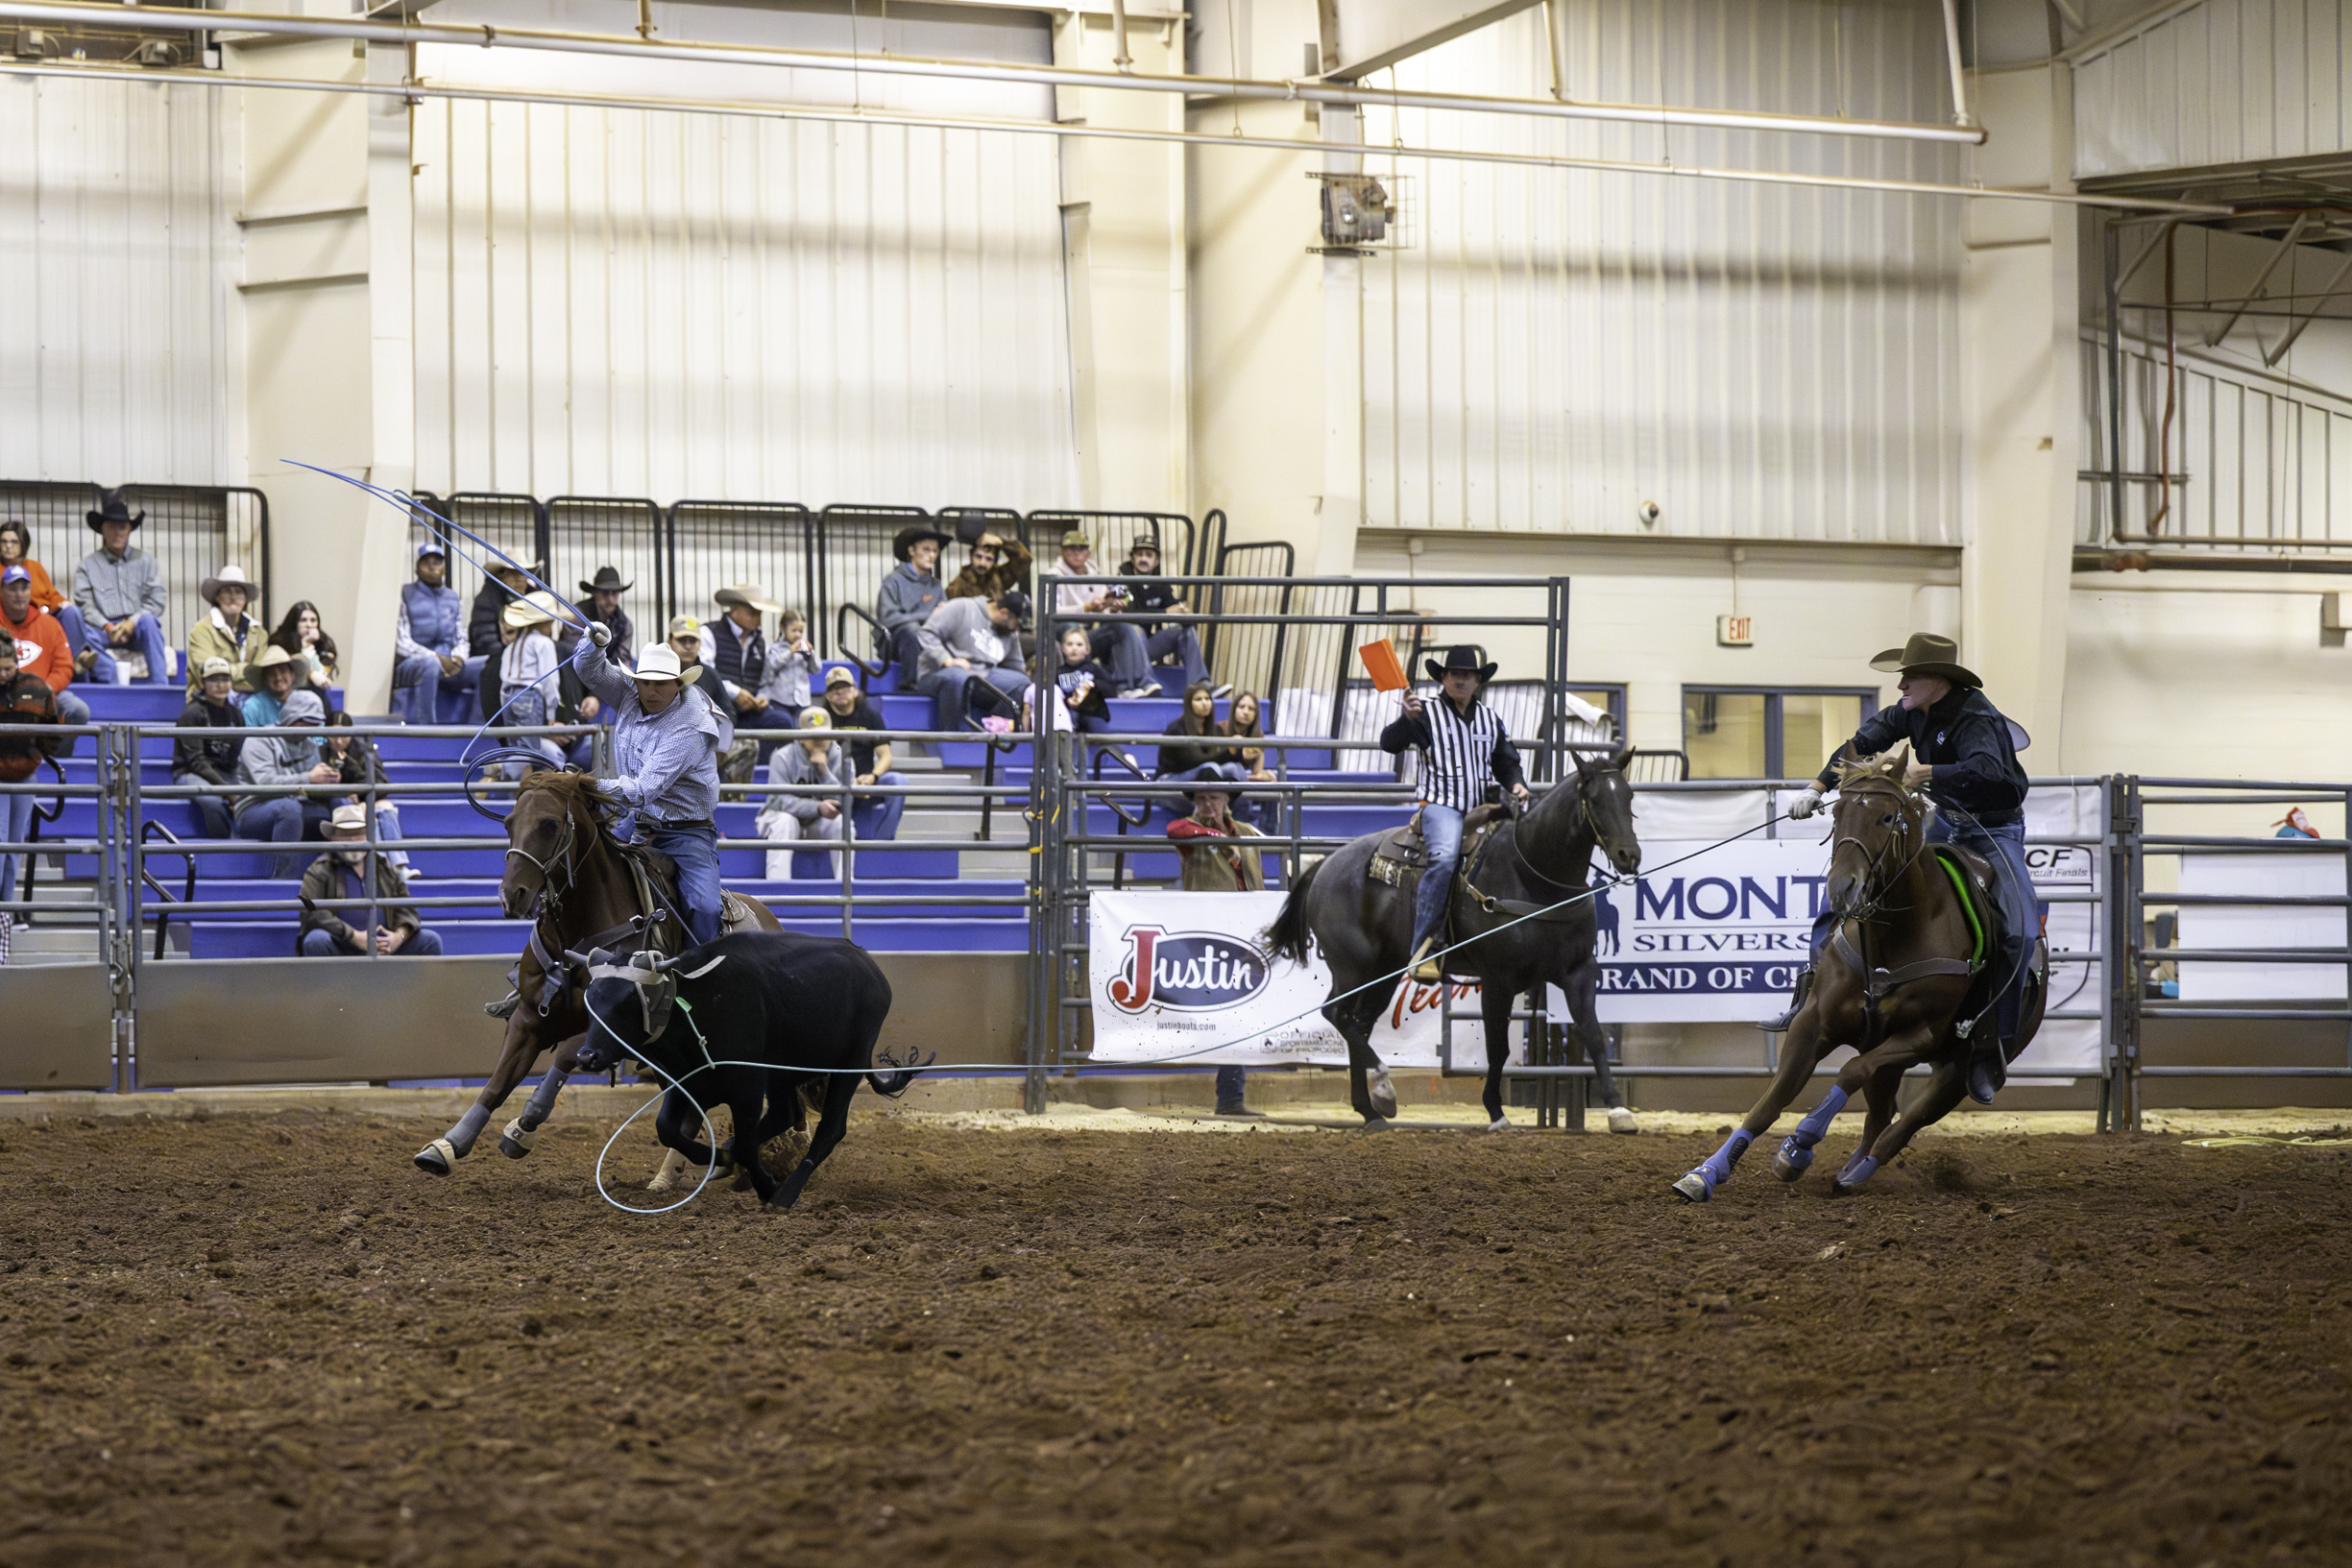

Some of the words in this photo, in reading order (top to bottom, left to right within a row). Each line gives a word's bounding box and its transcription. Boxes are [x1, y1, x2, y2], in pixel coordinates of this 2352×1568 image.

[1730, 616, 1751, 639] EXIT
[2055, 868, 2088, 878] Finals
[1111, 929, 1253, 1010] Justin
[1595, 968, 1697, 990] RAND
[1708, 967, 1754, 989] OF
